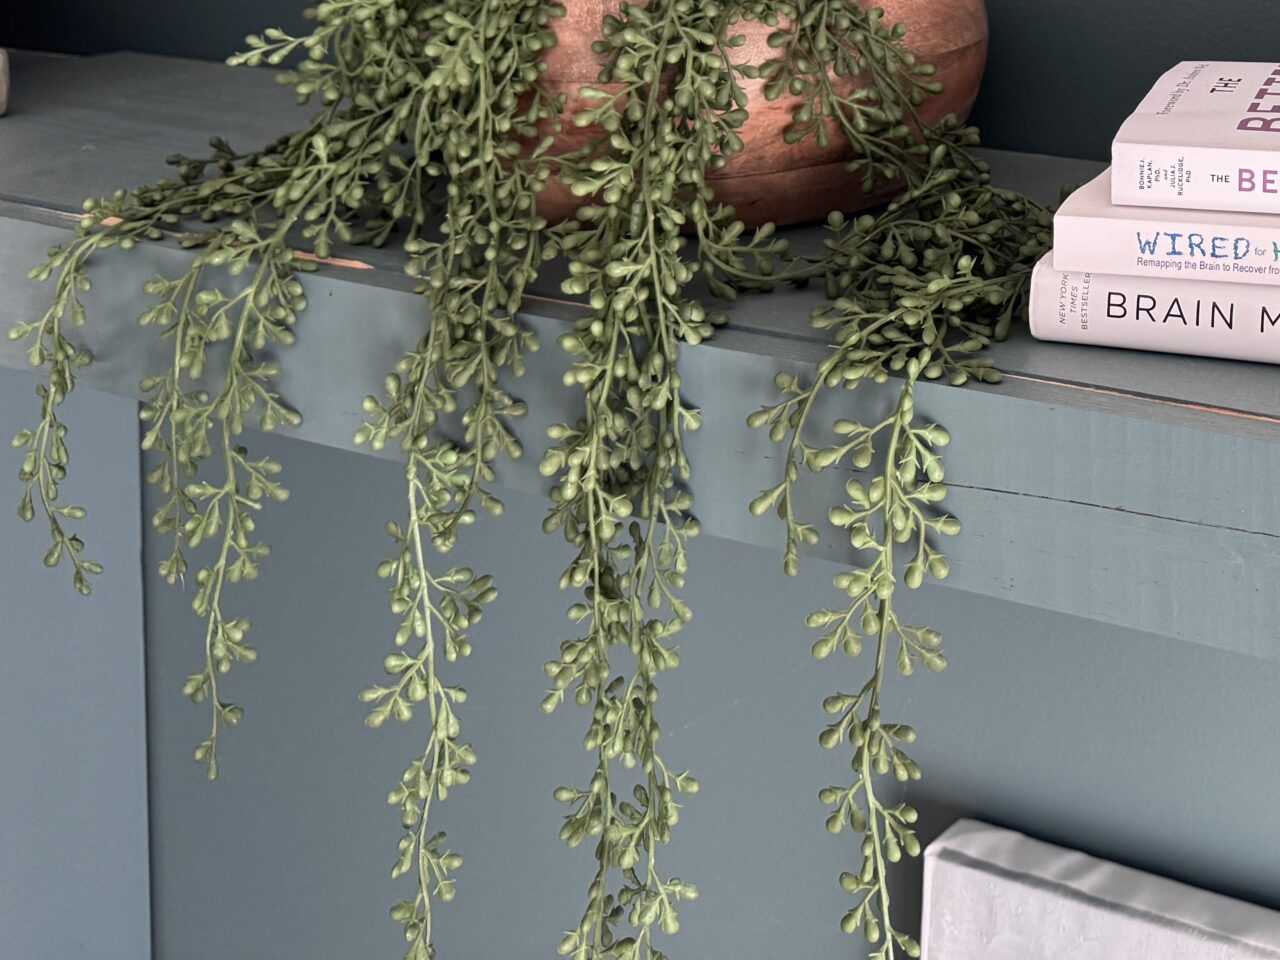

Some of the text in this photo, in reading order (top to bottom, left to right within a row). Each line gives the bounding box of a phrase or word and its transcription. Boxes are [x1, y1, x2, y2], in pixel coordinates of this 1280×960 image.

[1209, 77, 1242, 93] THE
[1210, 174, 1230, 183] THE
[1136, 231, 1251, 260] WIRED
[1254, 246, 1266, 257] for
[1137, 257, 1182, 271] Remapping
[1184, 259, 1197, 270] the
[1199, 260, 1221, 272] Brain
[1223, 263, 1231, 272] to
[1233, 263, 1267, 275] Recover
[1060, 273, 1069, 299] YORK
[1070, 285, 1078, 313] TIMES
[1081, 272, 1092, 330] BESTSELLER
[1106, 291, 1234, 330] BRAIN
